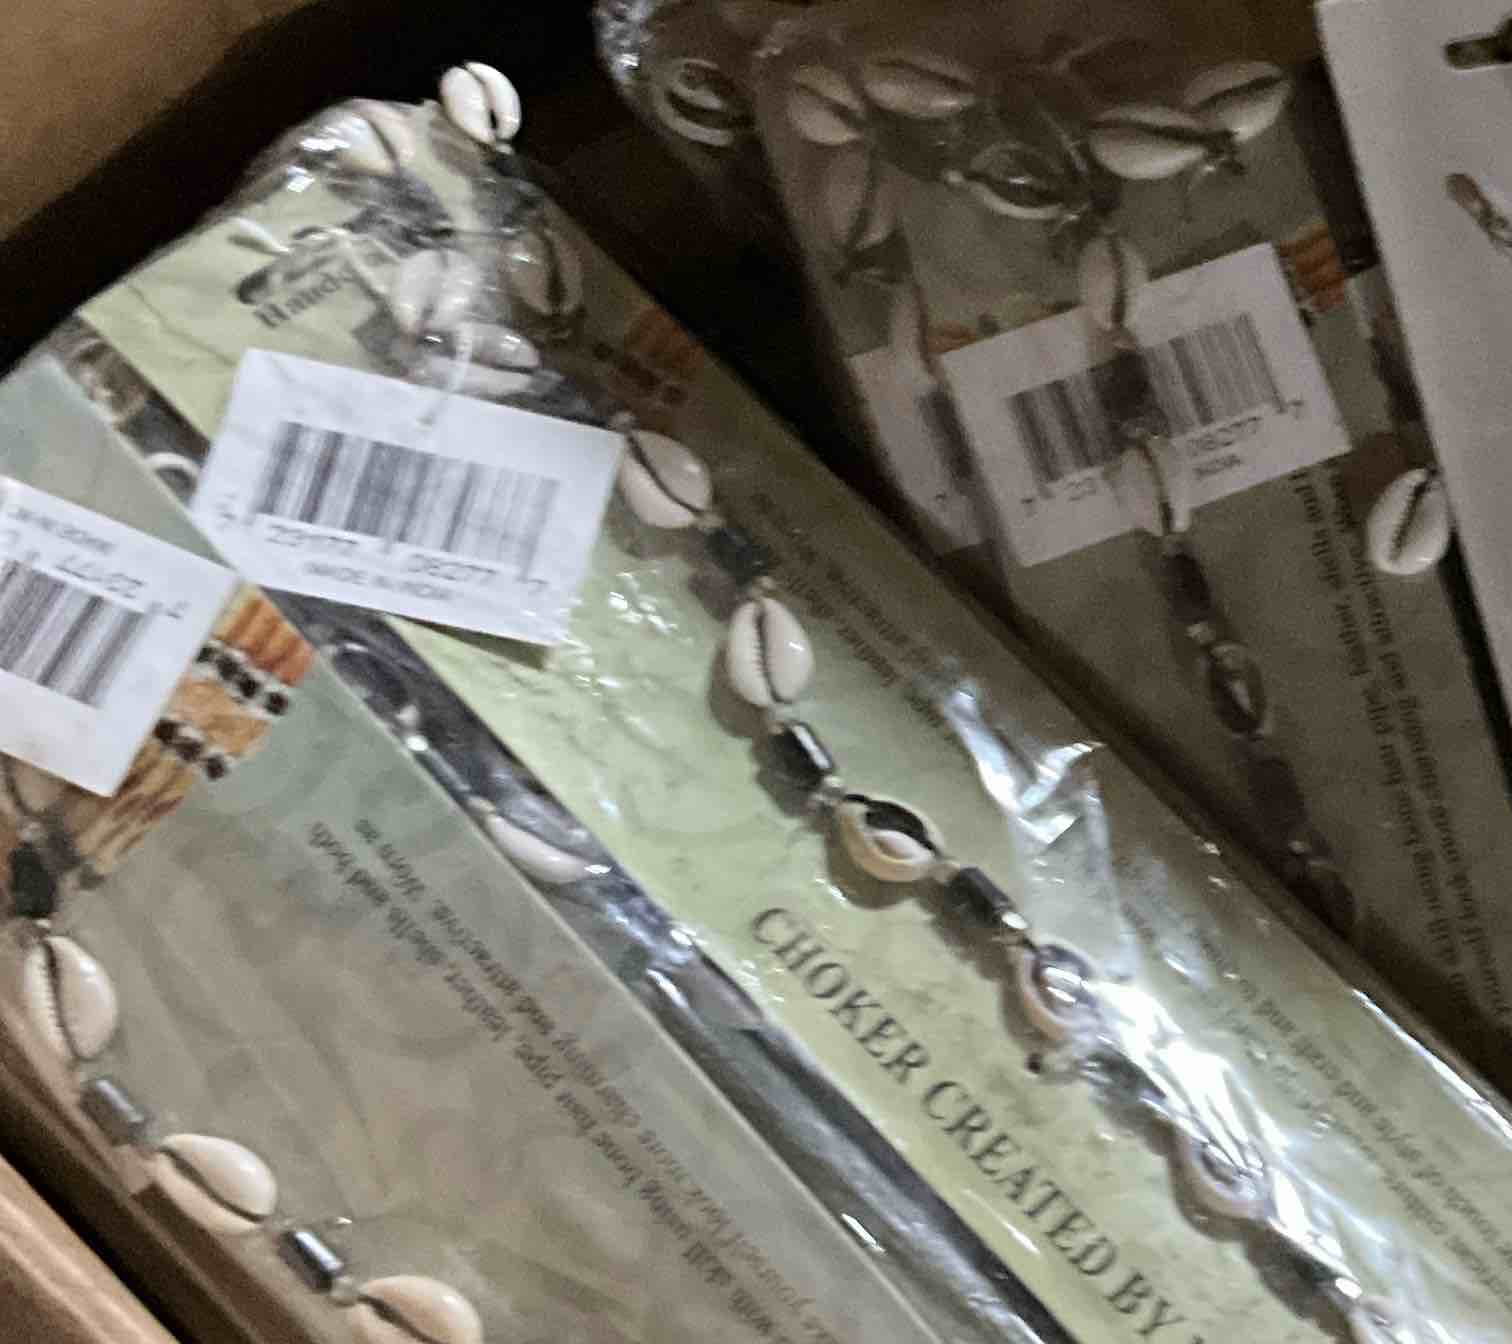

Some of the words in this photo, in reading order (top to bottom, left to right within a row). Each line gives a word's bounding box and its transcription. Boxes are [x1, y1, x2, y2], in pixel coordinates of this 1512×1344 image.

[749, 907, 929, 1086] CHOKER
[921, 1079, 1129, 1278] CREATED
[1104, 1272, 1187, 1339] BY
